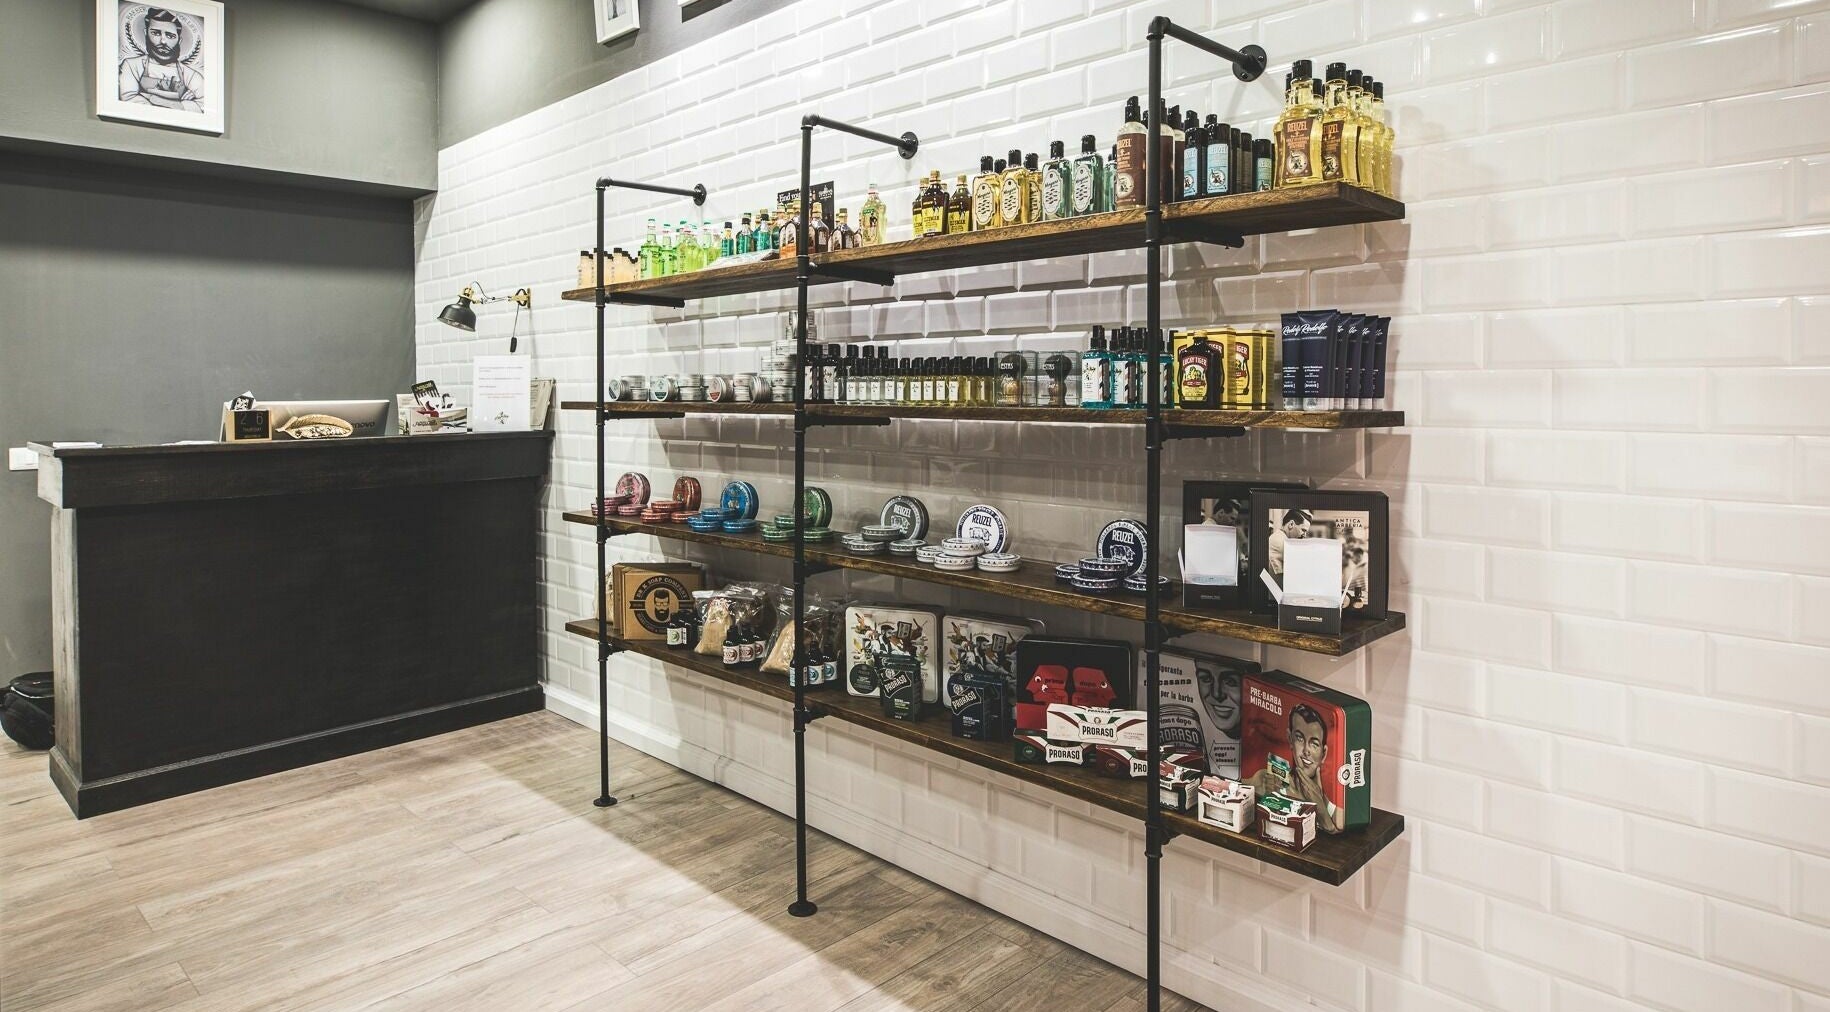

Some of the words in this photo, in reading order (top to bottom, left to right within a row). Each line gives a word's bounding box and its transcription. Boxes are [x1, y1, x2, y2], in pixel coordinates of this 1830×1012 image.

[1288, 121, 1308, 133] REUZEL
[1183, 357, 1195, 367] LUCKY
[1196, 356, 1207, 367] TIGER
[352, 421, 375, 429] novo
[893, 504, 911, 518] REUZEL
[972, 513, 992, 527] REUZEL
[1112, 530, 1134, 545] REUZEL
[648, 577, 662, 585] SOAP
[884, 674, 907, 693] PRORASO
[952, 690, 977, 710] PRORASO
[1160, 690, 1170, 698] per
[1170, 691, 1177, 700] la
[1178, 692, 1194, 704] barba
[1250, 686, 1282, 706] PRE-BARBA
[1250, 695, 1282, 716] MIRACOLO
[1176, 716, 1192, 726] dopo
[1082, 725, 1114, 738] PRORASO
[1160, 728, 1199, 744] RORASO
[1049, 749, 1080, 760] PRORASO
[1353, 752, 1362, 785] PRORASO
[1270, 814, 1287, 823] PRORASO
